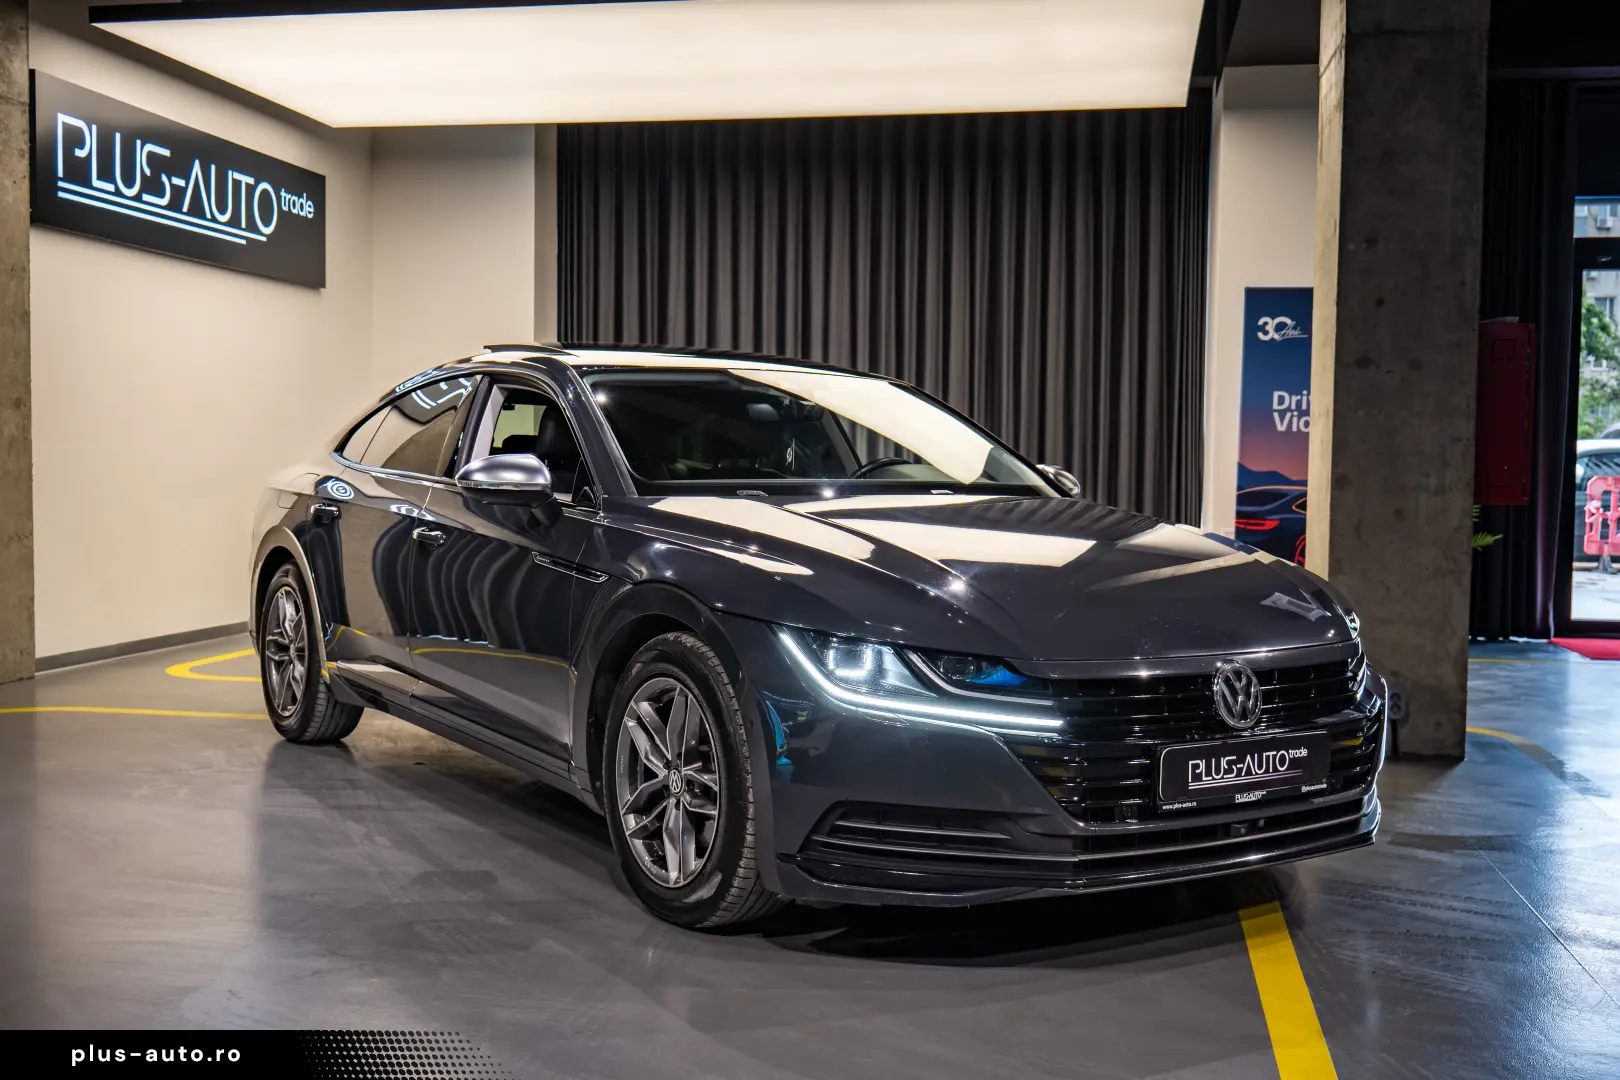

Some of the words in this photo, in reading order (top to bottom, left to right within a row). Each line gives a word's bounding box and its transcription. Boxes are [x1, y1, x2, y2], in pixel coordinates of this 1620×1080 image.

[57, 112, 278, 235] PLUS-AUTO
[280, 187, 314, 218] trade
[1257, 316, 1293, 341] 30
[1272, 390, 1312, 410] Dri
[1188, 750, 1289, 782] PLUS-AUTO
[1288, 746, 1308, 758] trade
